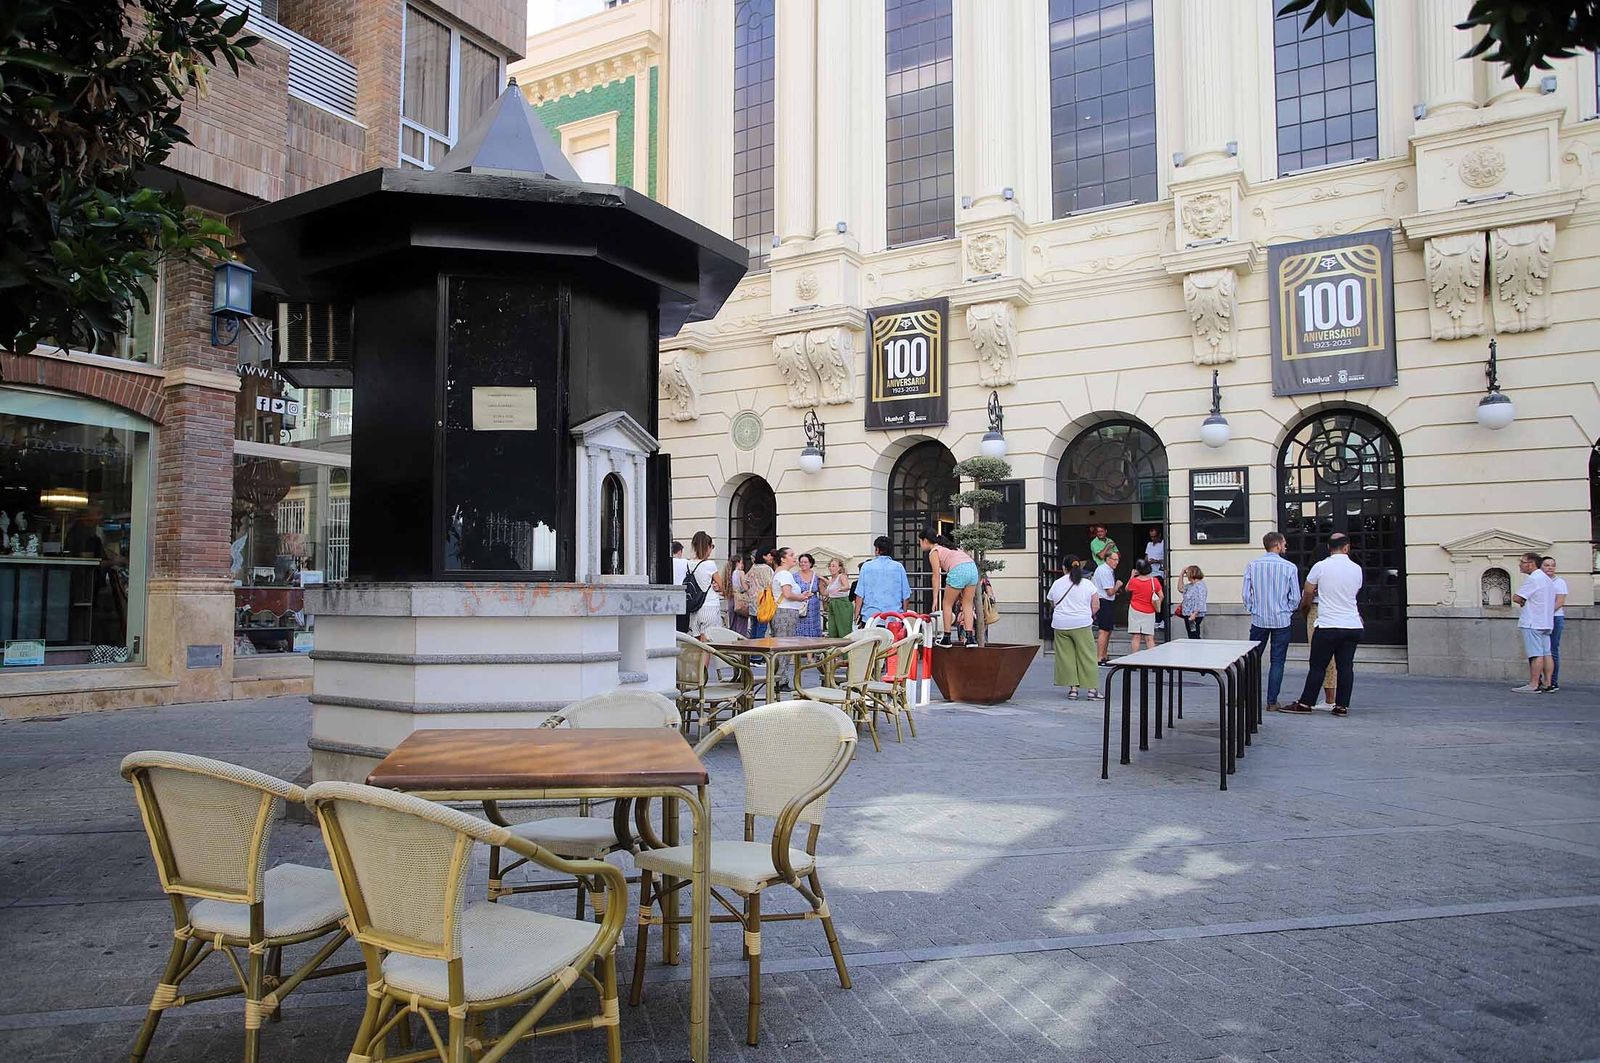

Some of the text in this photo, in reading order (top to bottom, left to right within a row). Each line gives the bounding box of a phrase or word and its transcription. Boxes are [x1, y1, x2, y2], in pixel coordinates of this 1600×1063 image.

[1299, 278, 1362, 331] 100
[1303, 327, 1361, 343] ANIVERSARIO
[1312, 339, 1352, 349] 1923-2023
[884, 337, 927, 379] 100
[886, 377, 926, 388] ANIVERSARIO
[1302, 375, 1331, 385] Huelva
[892, 386, 919, 394] 1923-2023
[884, 415, 904, 423] Huelva
